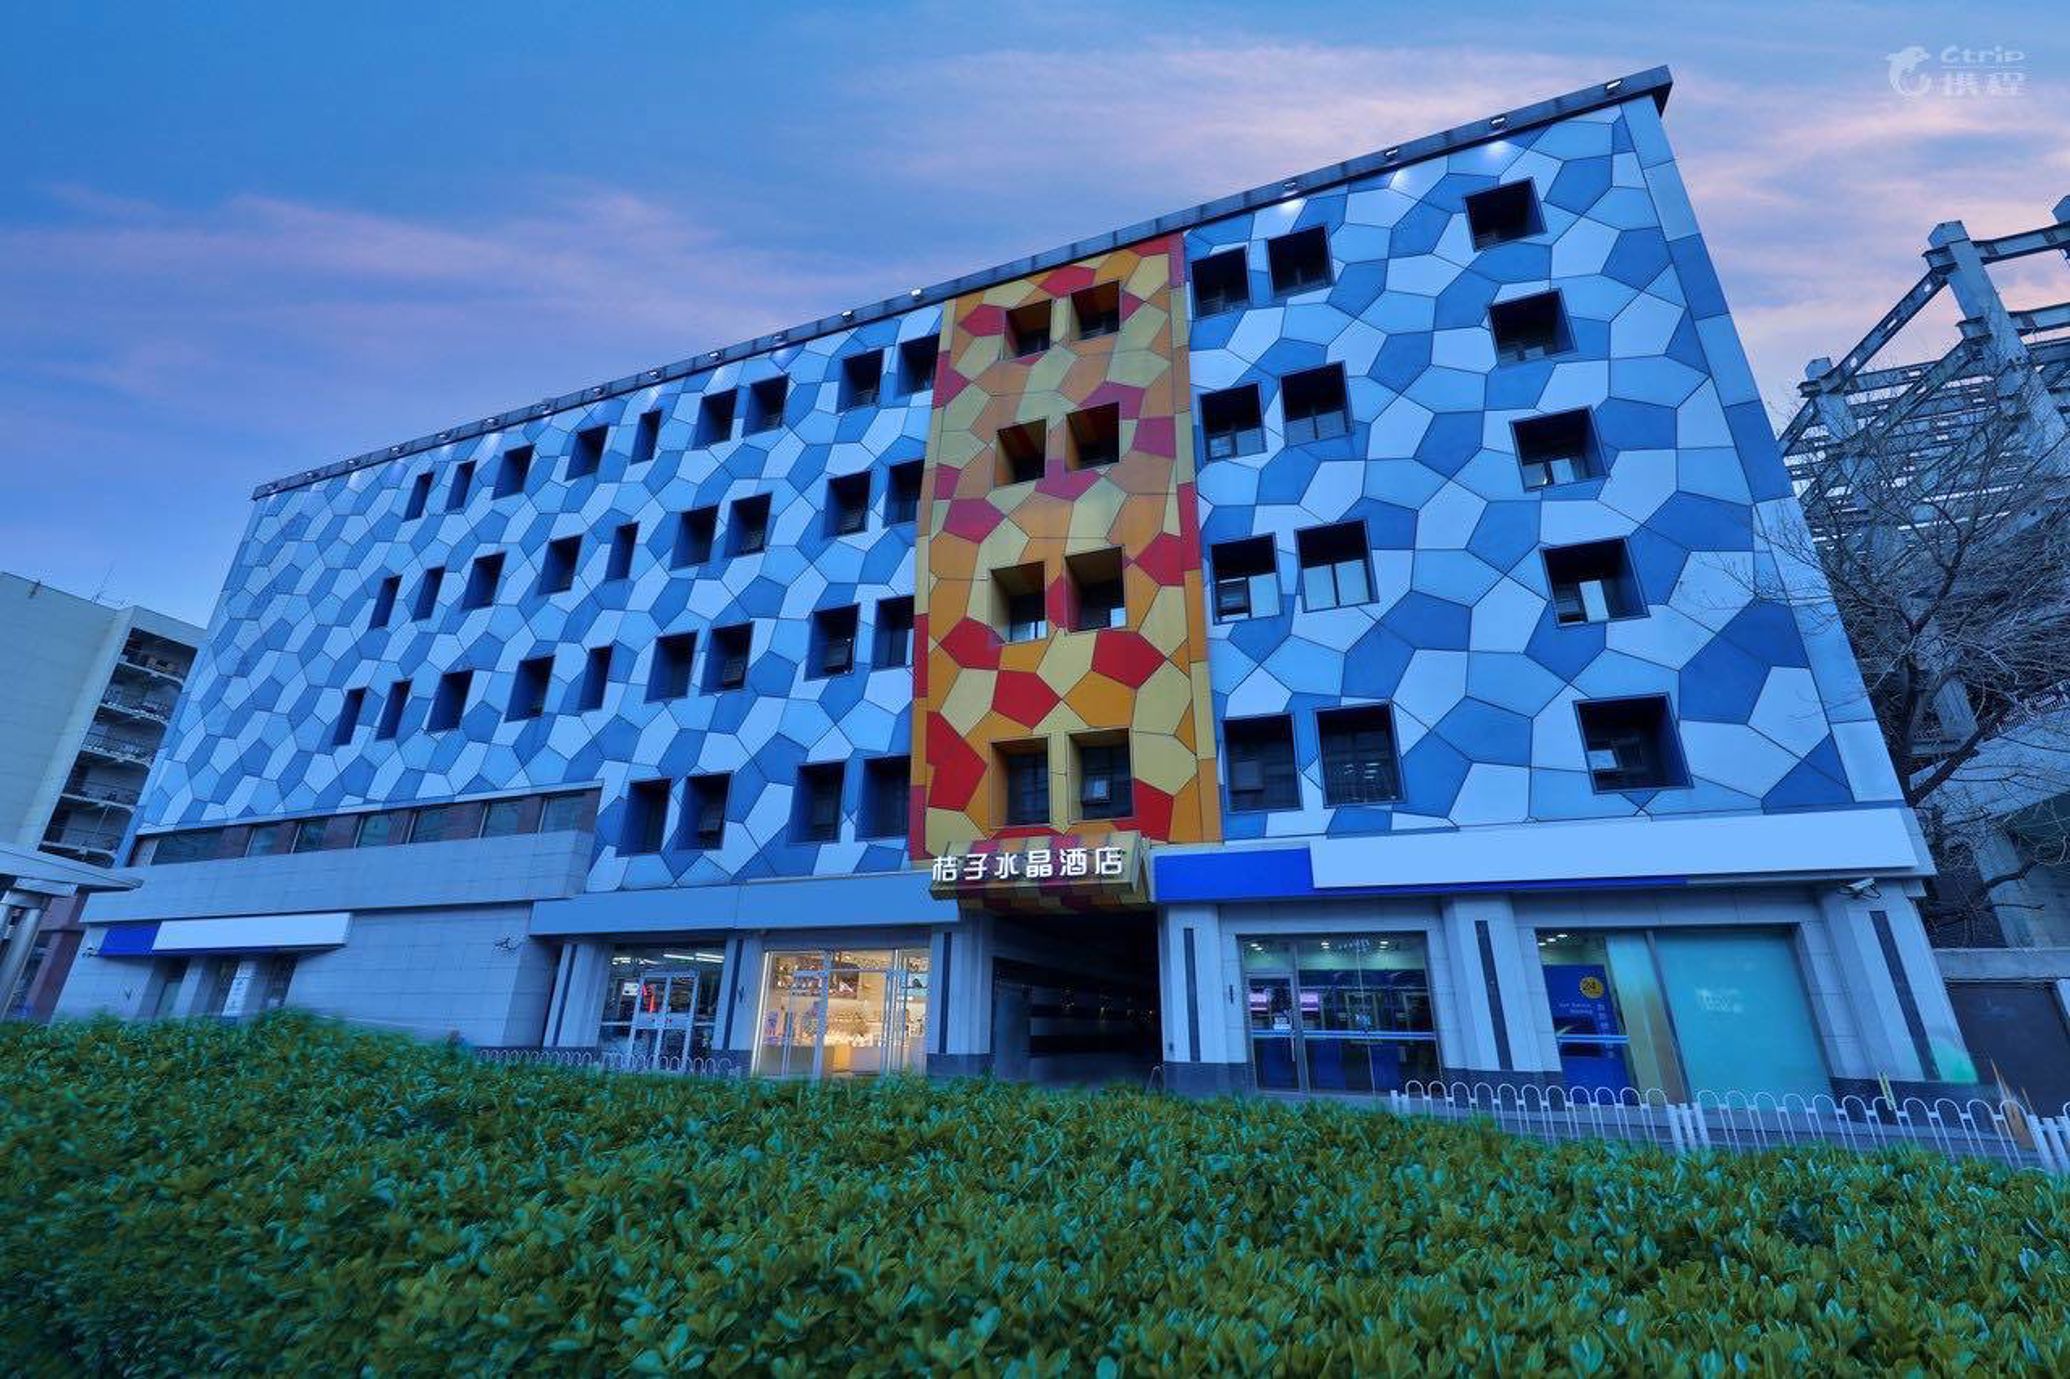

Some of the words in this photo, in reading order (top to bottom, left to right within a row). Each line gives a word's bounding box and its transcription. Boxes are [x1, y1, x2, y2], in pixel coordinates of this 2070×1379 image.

[931, 846, 1125, 881] 桔子水晶酒店
